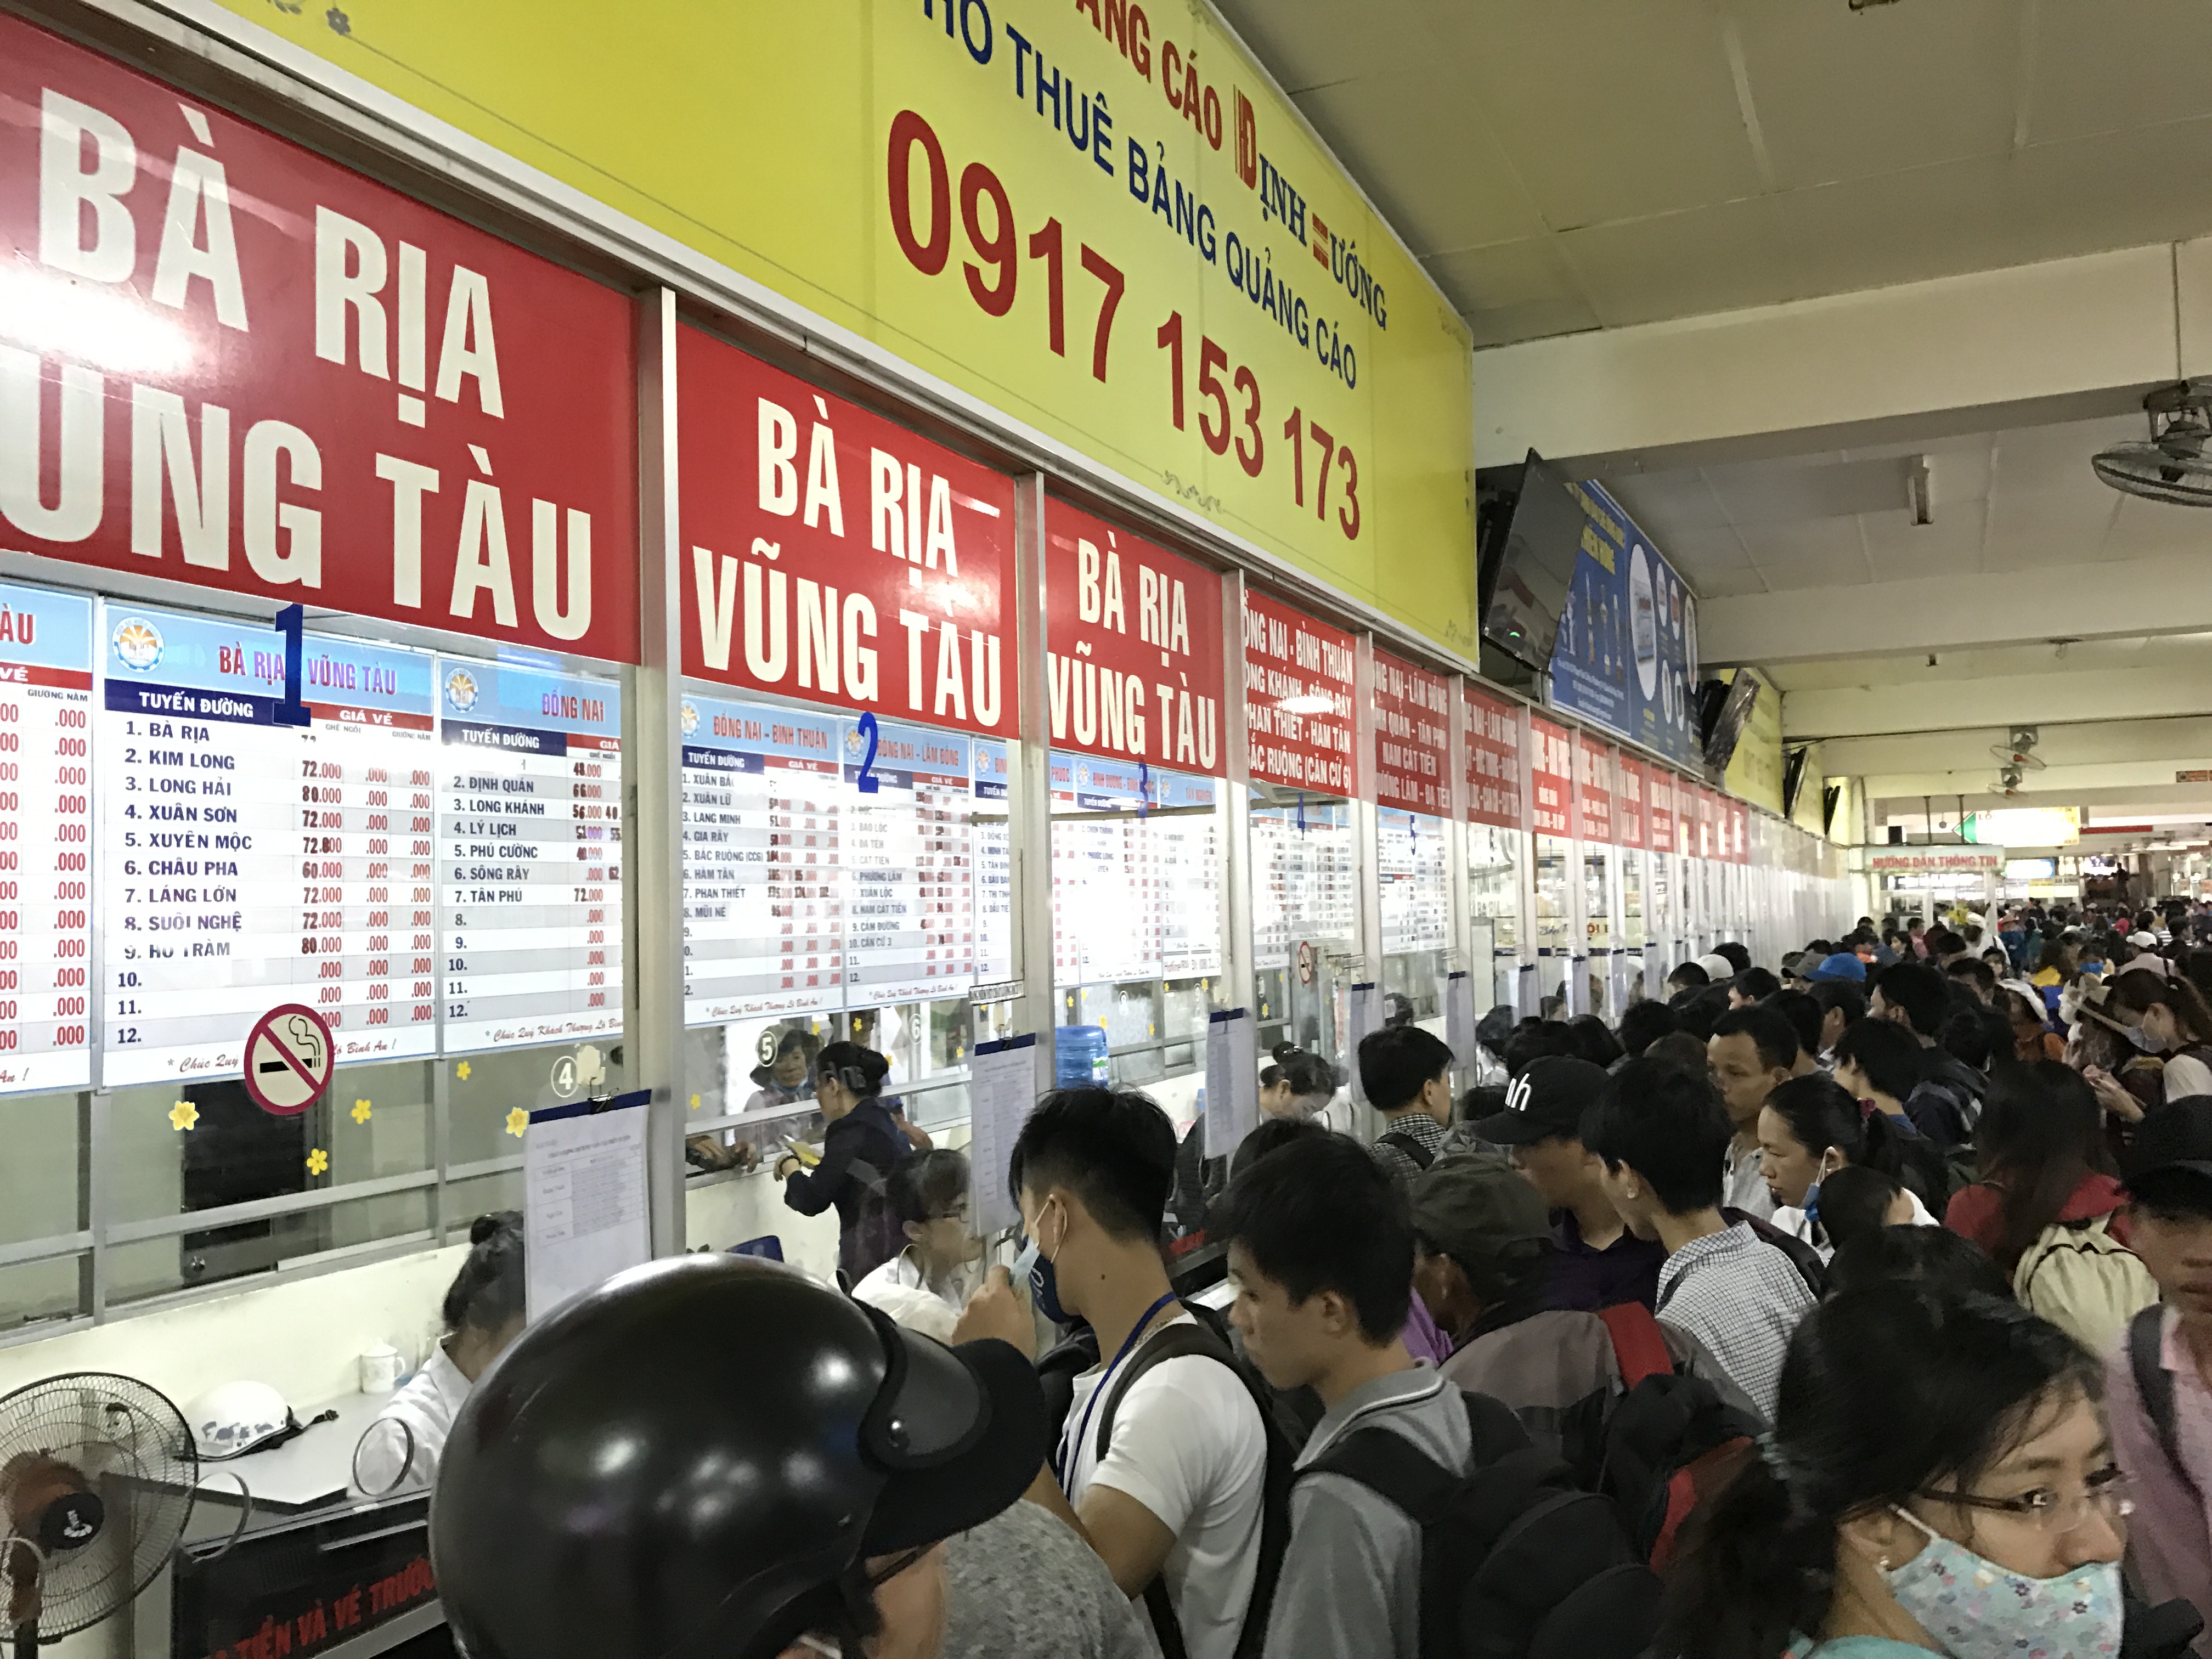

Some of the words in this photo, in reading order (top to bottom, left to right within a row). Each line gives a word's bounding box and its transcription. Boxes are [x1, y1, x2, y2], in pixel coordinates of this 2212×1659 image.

[1162, 41, 1222, 151] CÁO
[1006, 22, 1114, 177] THUÊ
[1128, 136, 1216, 265] BẢNG
[1226, 232, 1309, 349] QUẢNG
[1316, 318, 1356, 390] CÁO
[38, 87, 249, 332] BÀ
[315, 205, 505, 428] RỊA
[887, 109, 1125, 383] 0917
[1157, 310, 1263, 477] 153
[1284, 406, 1360, 540] 173
[758, 394, 844, 538] BÀ
[871, 447, 958, 589] RỊA
[376, 444, 592, 641] TÀU
[1078, 530, 1126, 635] BÀ
[1139, 564, 1190, 668] RỊA
[692, 538, 878, 702] VŨNG
[900, 595, 1001, 727] TÀU
[1269, 618, 1288, 661] NAI
[1296, 621, 1321, 673] BÌNH
[0, 666, 29, 682] VÉ
[219, 641, 246, 676] BÀ
[254, 650, 286, 685] RỊA
[307, 654, 357, 690] VŨNG
[362, 662, 397, 695] TÀU
[275, 603, 311, 727] 1
[1268, 666, 1302, 699] KHÁNH
[139, 691, 196, 713] TUYẾN
[200, 698, 254, 718] ĐƯỜNG
[542, 689, 578, 719] ĐỒNG
[582, 698, 605, 722] NAI
[1047, 640, 1146, 756] VŨNG
[1156, 672, 1216, 769] TÀU
[55, 709, 86, 729] .000
[340, 709, 367, 723] GIÁ
[373, 711, 393, 725] VÉ
[127, 721, 142, 736] 1.
[149, 720, 173, 738] BÀ
[181, 726, 210, 744] RỊA
[462, 727, 500, 745] TUYẾN
[503, 732, 540, 749] ĐƯỜNG
[745, 720, 762, 741] NAI
[1311, 714, 1331, 749] HÀM
[1333, 723, 1351, 754] TÂN
[55, 738, 86, 757] .000
[600, 739, 619, 751] GIÁ
[858, 712, 879, 793] 2
[125, 748, 142, 763] 2.
[149, 751, 183, 766] KIM
[190, 753, 235, 770] LONG
[1267, 744, 1303, 785] RUỘNG
[1305, 752, 1328, 787] (CĂN
[1329, 755, 1342, 788] CỨ
[1343, 765, 1352, 794] 6)
[302, 760, 342, 780] 72.000
[693, 770, 717, 786] XUÂN
[125, 777, 142, 792] 3.
[149, 778, 196, 794] LONG
[202, 776, 231, 796] HẢI
[469, 777, 498, 792] ĐỊNH
[503, 776, 534, 793] QUÁN
[302, 786, 342, 804] 80.000
[125, 804, 142, 820] 4.
[149, 802, 198, 821] XUÂN
[204, 806, 237, 823] SƠN
[470, 799, 501, 813] LONG
[505, 798, 545, 815] KHÁNH
[302, 810, 342, 829] 72.000
[470, 820, 485, 835] LÝ
[489, 823, 517, 838] LỊCH
[125, 832, 142, 847] 5.
[149, 830, 210, 849] XUYÊN
[216, 832, 252, 853] MỘC
[693, 831, 708, 842] GIA
[470, 843, 494, 857] PHÚ
[499, 843, 538, 858] CƯỜNG
[1938, 854, 1976, 867] THÔNG
[1978, 855, 1997, 866] TIN
[124, 860, 142, 876] 6.
[149, 857, 198, 876] CHÂU
[205, 861, 238, 876] PHA
[302, 861, 342, 879] 60.000
[470, 865, 503, 880] SÔNG
[125, 889, 142, 903] 7.
[149, 884, 197, 903] LÁNG
[204, 883, 236, 903] LỚN
[303, 887, 342, 904] 72.000
[470, 887, 495, 902] TÂN
[499, 886, 523, 902] PHÚ
[695, 888, 719, 899] PHAN
[124, 917, 142, 932] 8.
[198, 911, 242, 933] NGHỆ
[302, 912, 342, 930] 72.000
[301, 936, 342, 953] 80.000
[118, 972, 142, 988] 10.
[118, 1000, 142, 1015] 11.
[117, 1029, 142, 1043] 12.
[760, 1037, 773, 1060] 5
[558, 1063, 574, 1090] 4
